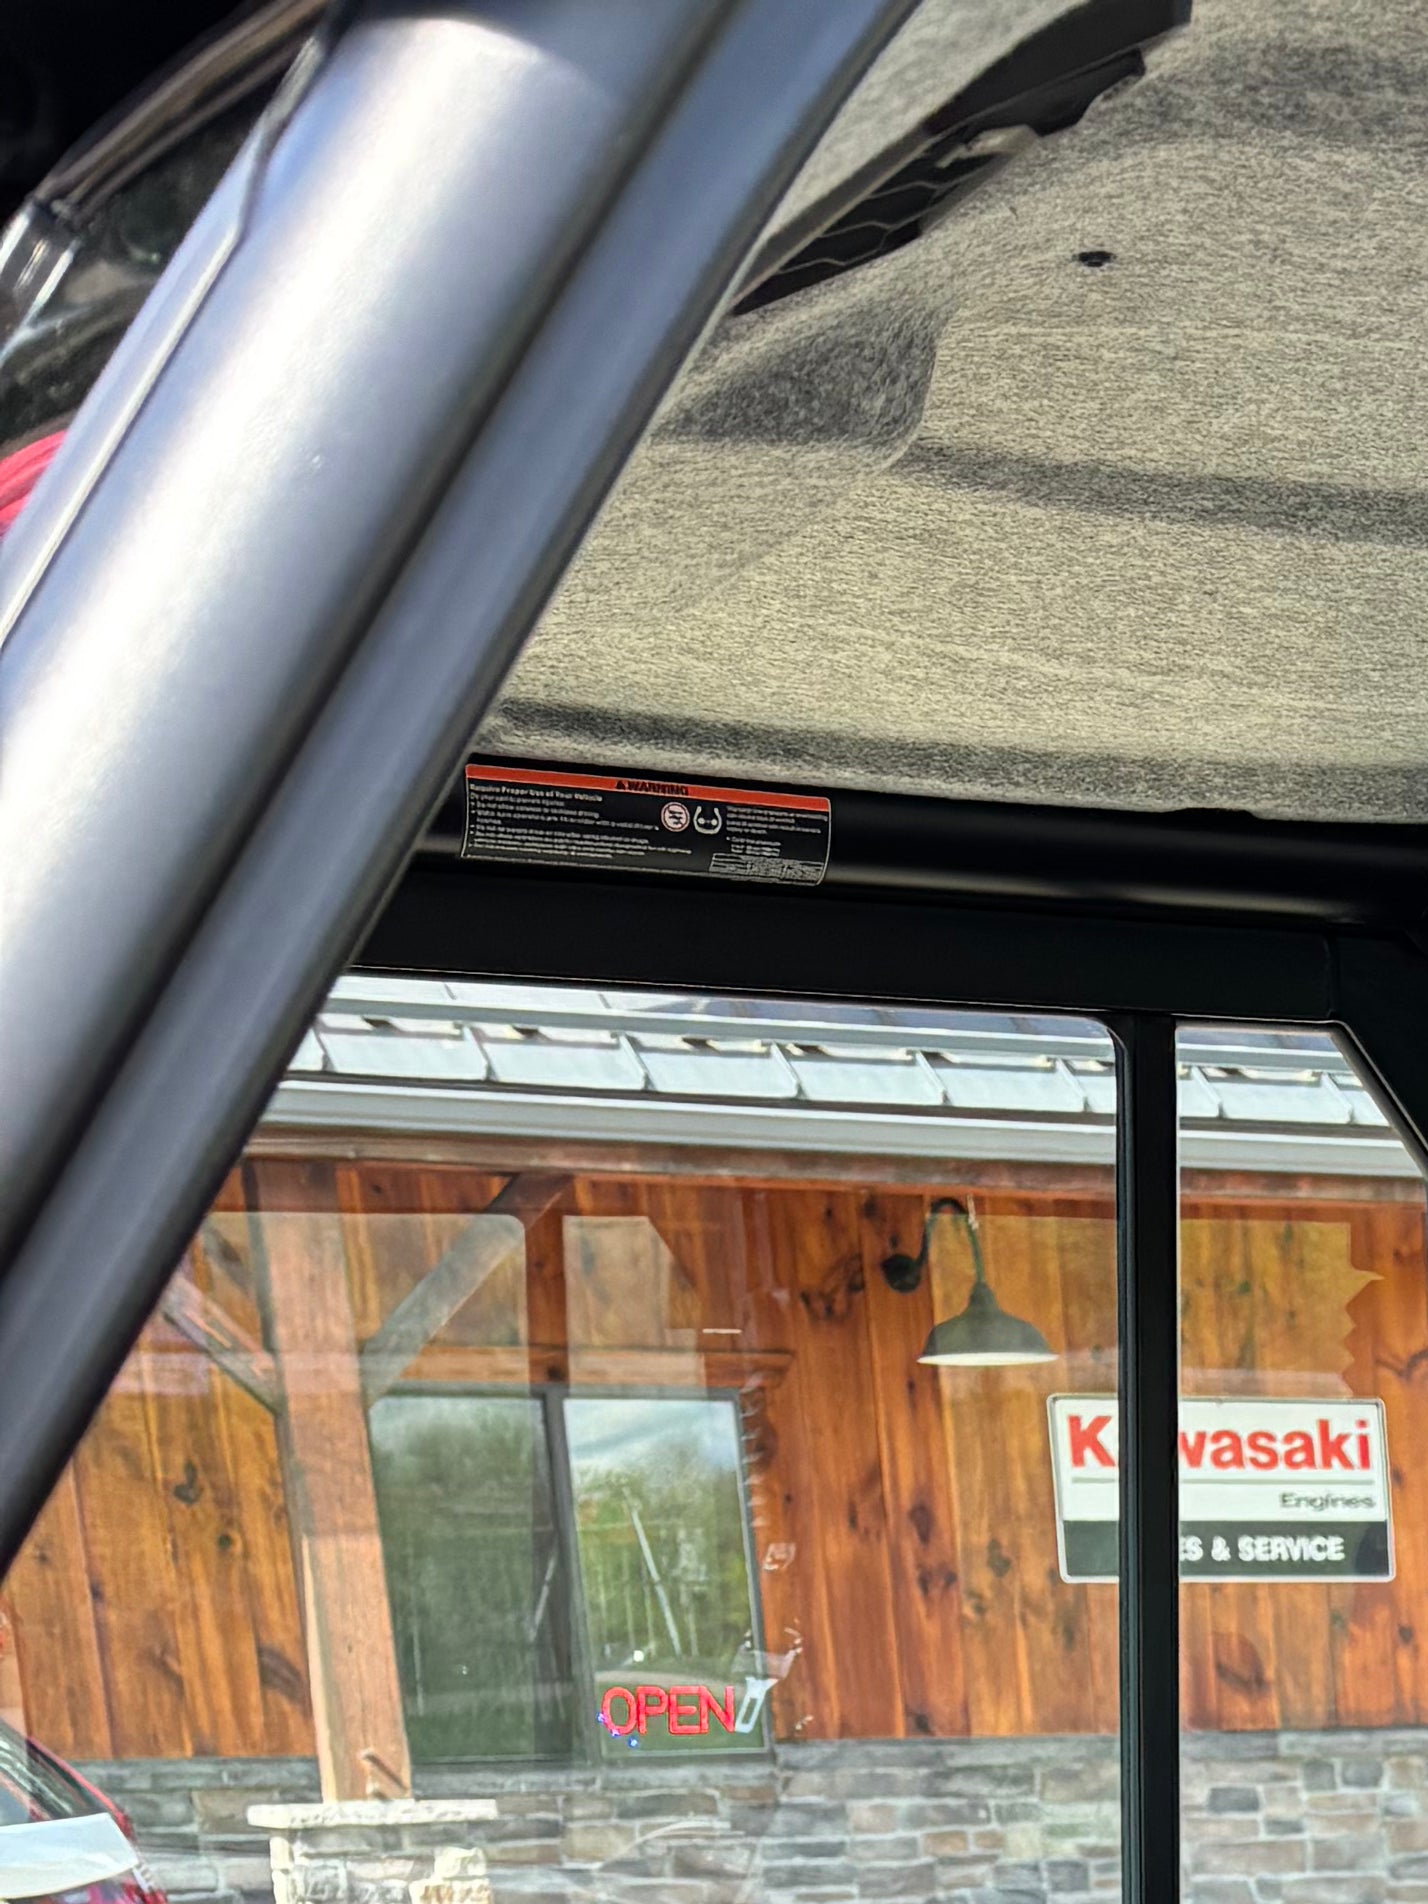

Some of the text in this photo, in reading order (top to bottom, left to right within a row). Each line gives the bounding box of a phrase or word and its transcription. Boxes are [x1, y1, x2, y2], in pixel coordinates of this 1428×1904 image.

[1067, 1415, 1372, 1471] Kwasaki
[1279, 1492, 1377, 1513] Engines
[1210, 1535, 1231, 1562] &
[1238, 1535, 1345, 1562] SERVICE
[601, 1685, 736, 1735] OPEN
